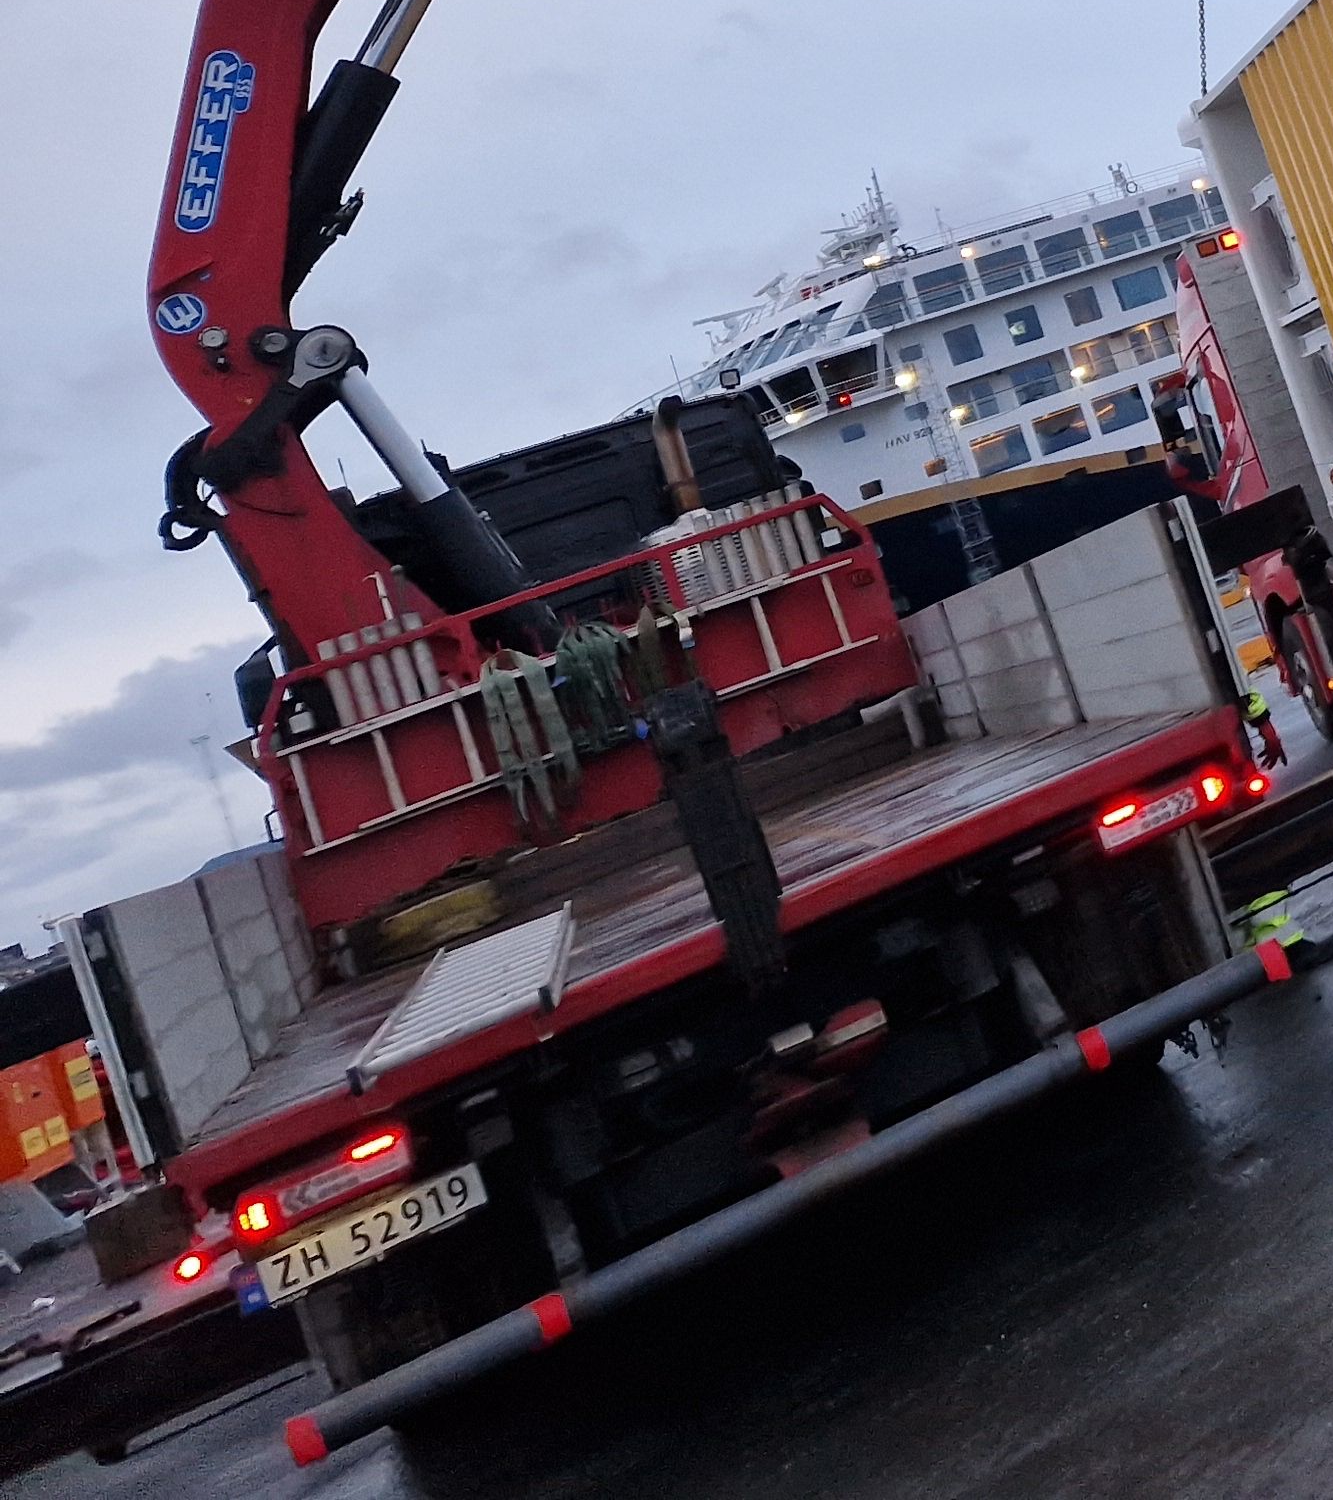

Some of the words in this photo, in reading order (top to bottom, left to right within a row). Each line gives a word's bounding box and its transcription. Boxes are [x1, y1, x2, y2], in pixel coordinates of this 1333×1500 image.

[180, 60, 238, 221] EFFER
[271, 1239, 330, 1291] ZH
[350, 1176, 468, 1256] 52919
